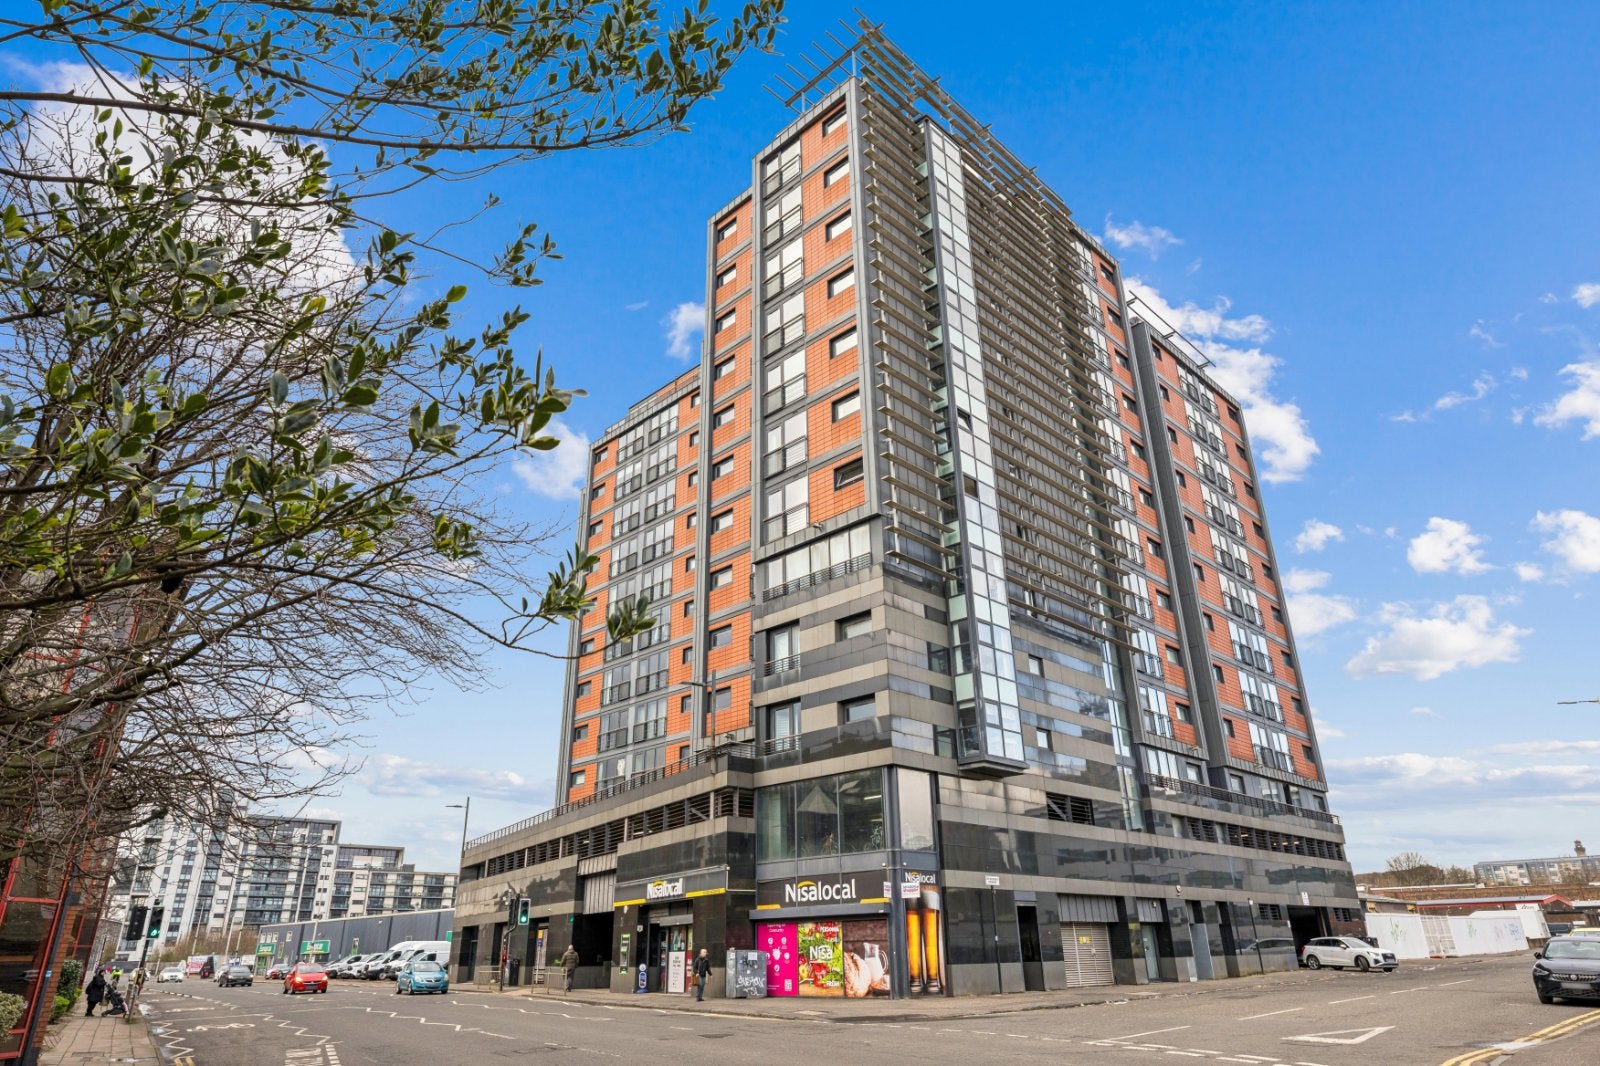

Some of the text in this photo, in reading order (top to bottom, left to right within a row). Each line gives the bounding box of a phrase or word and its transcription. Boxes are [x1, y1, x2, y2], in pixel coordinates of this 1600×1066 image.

[905, 871, 936, 884] Nisalocal
[647, 878, 683, 899] Nisalocal
[785, 879, 857, 903] Nisalocal
[809, 944, 833, 960] Nisa
